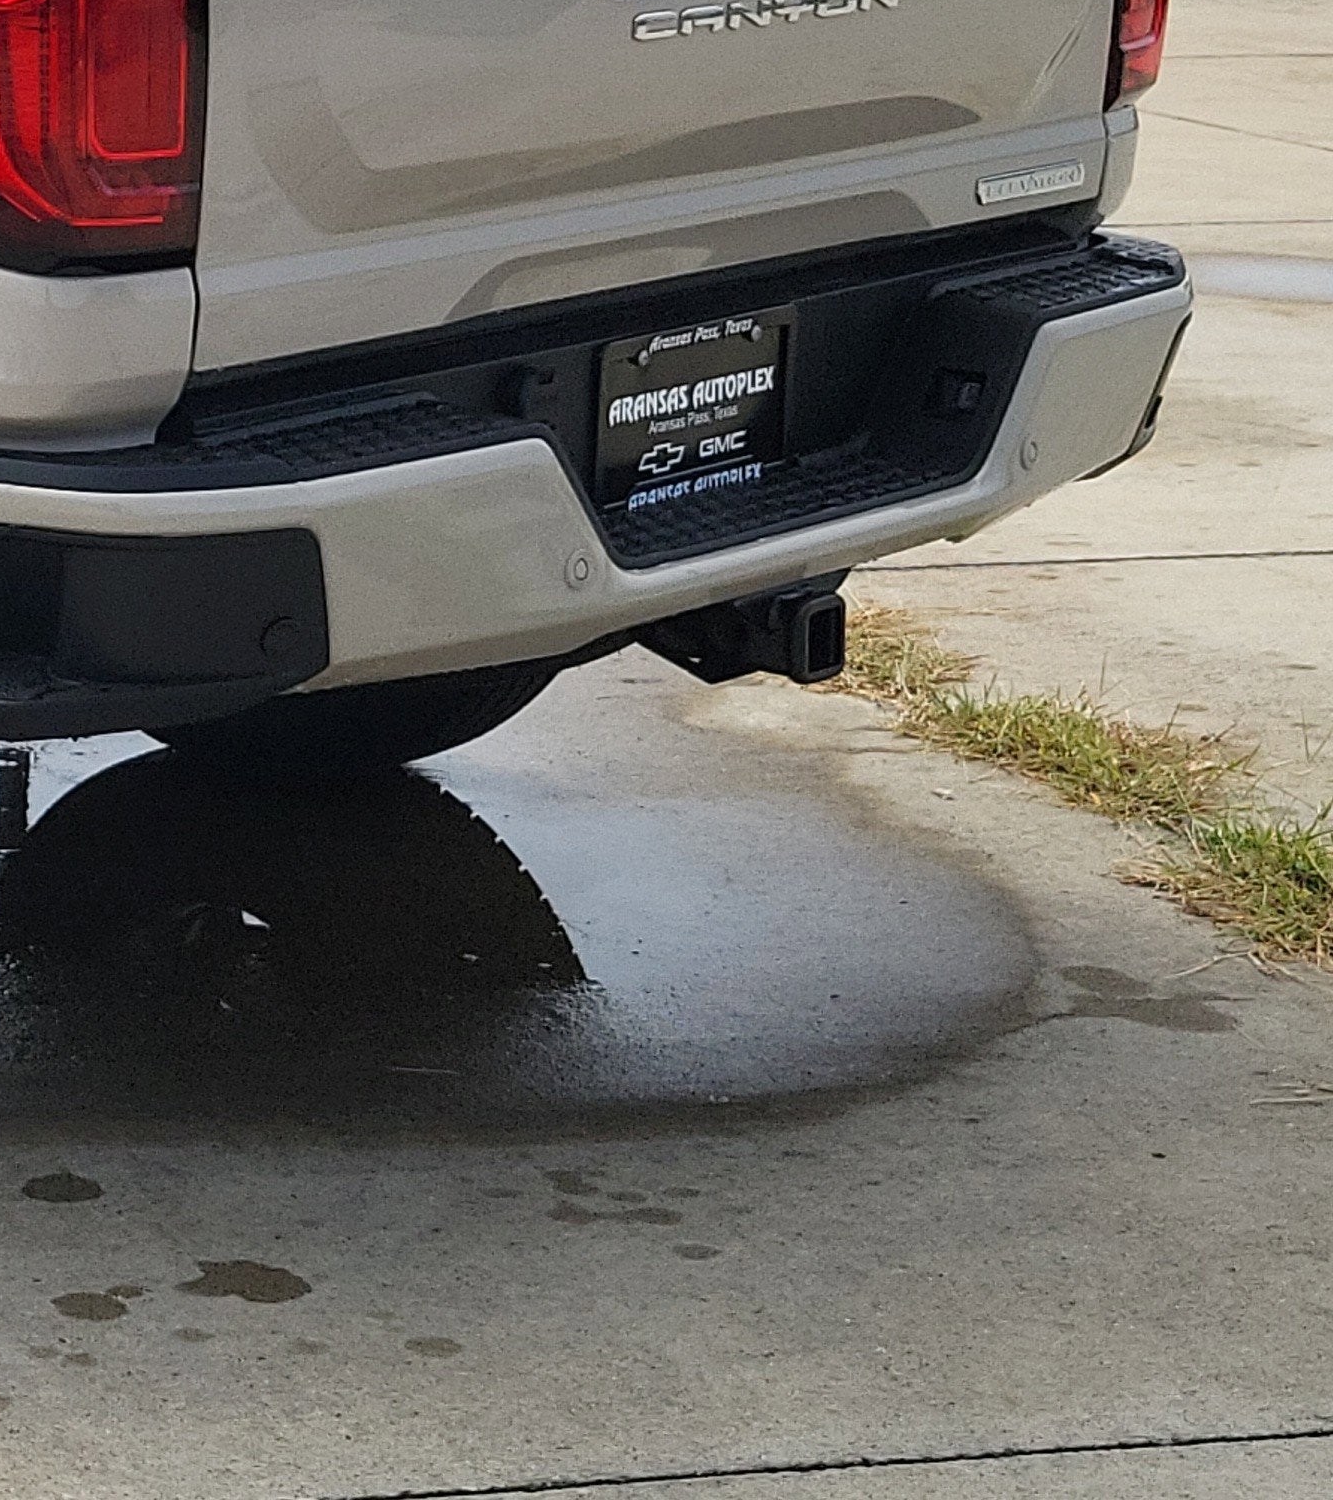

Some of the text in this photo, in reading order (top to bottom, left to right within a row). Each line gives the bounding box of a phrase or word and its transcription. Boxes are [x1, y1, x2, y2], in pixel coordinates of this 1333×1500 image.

[648, 331, 693, 354] Aransas
[608, 366, 775, 427] ARANSAS AUTOPLEX
[648, 415, 686, 435] Aransas
[713, 404, 738, 421] Texas
[699, 430, 747, 458] GMC
